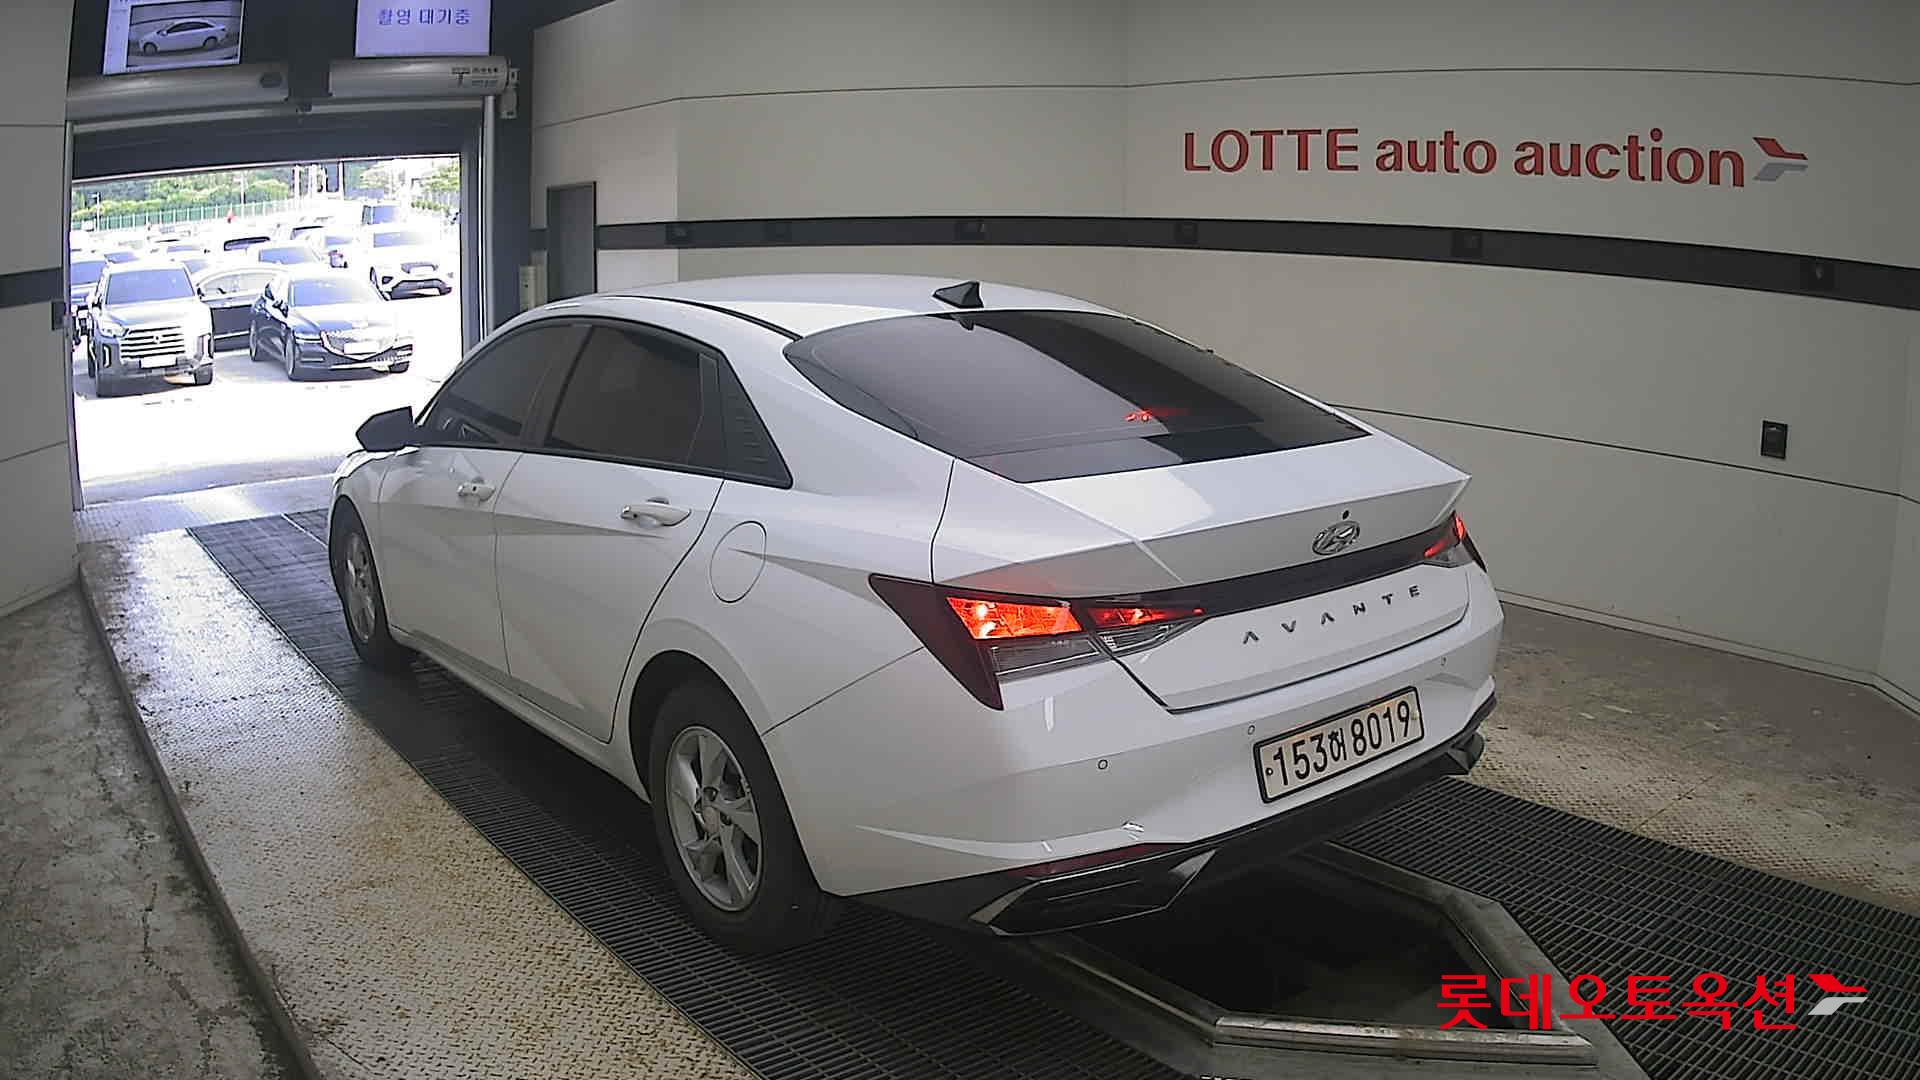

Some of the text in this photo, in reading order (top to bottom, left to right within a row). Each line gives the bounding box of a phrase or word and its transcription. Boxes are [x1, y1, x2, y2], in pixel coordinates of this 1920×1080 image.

[419, 7, 471, 25] 대기중
[1184, 127, 1745, 188] LOTTE auto auction
[1243, 585, 1421, 644] AVANTE
